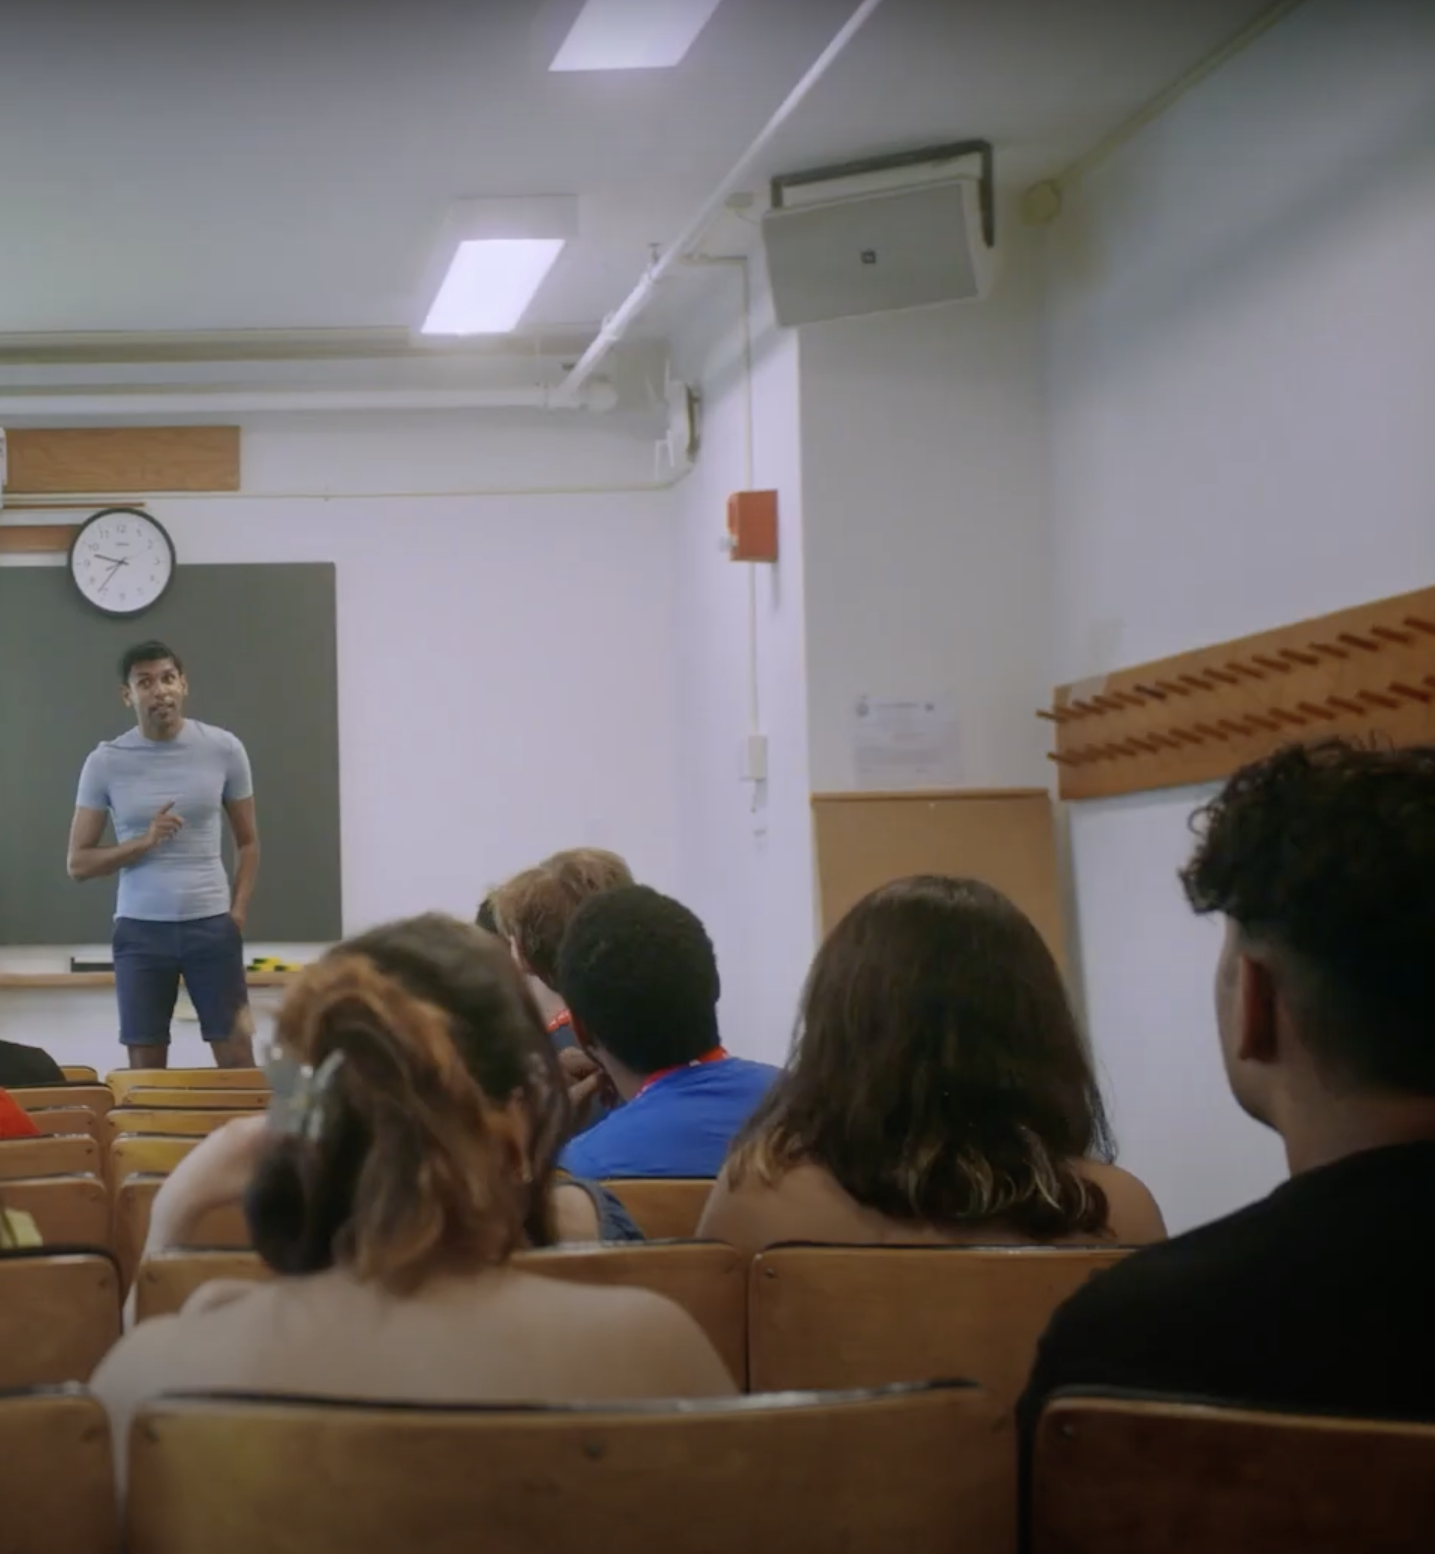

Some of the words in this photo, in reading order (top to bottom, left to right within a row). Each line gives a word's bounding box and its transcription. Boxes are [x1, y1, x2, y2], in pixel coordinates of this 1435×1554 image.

[99, 529, 110, 539] 11
[116, 524, 127, 534] 12
[88, 542, 100, 552] 10
